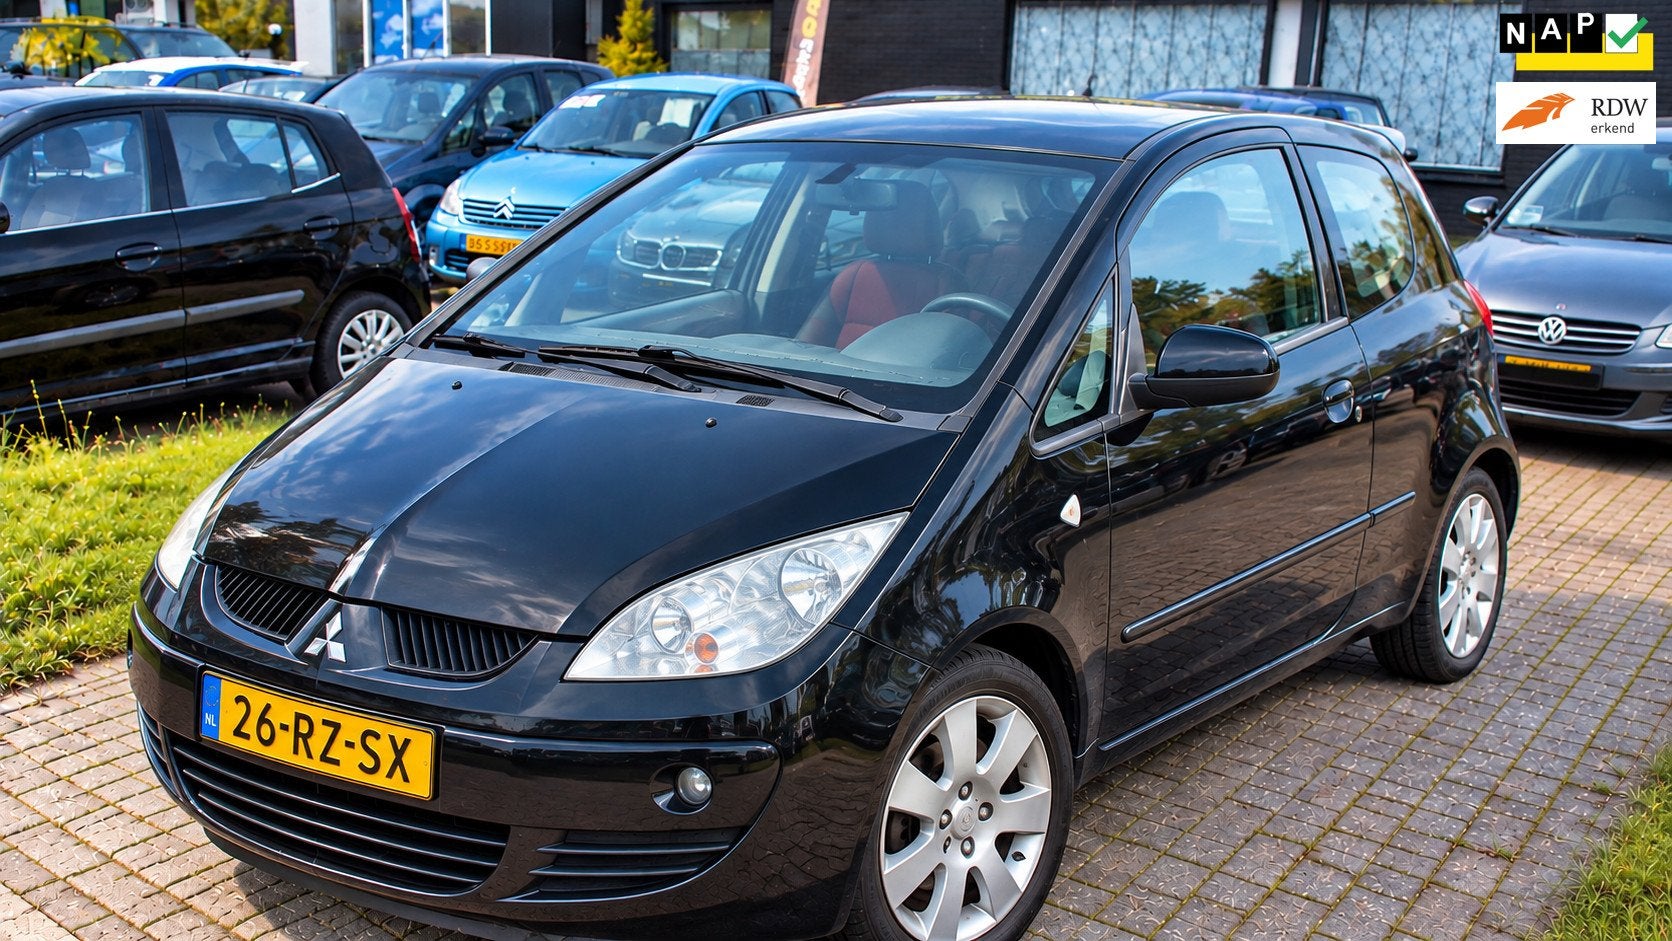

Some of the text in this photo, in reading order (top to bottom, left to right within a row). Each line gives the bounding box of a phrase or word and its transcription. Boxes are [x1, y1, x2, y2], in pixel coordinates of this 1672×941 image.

[1539, 318, 1566, 344] VW
[204, 712, 217, 727] NL
[232, 694, 412, 784] 26-RZ-SX
